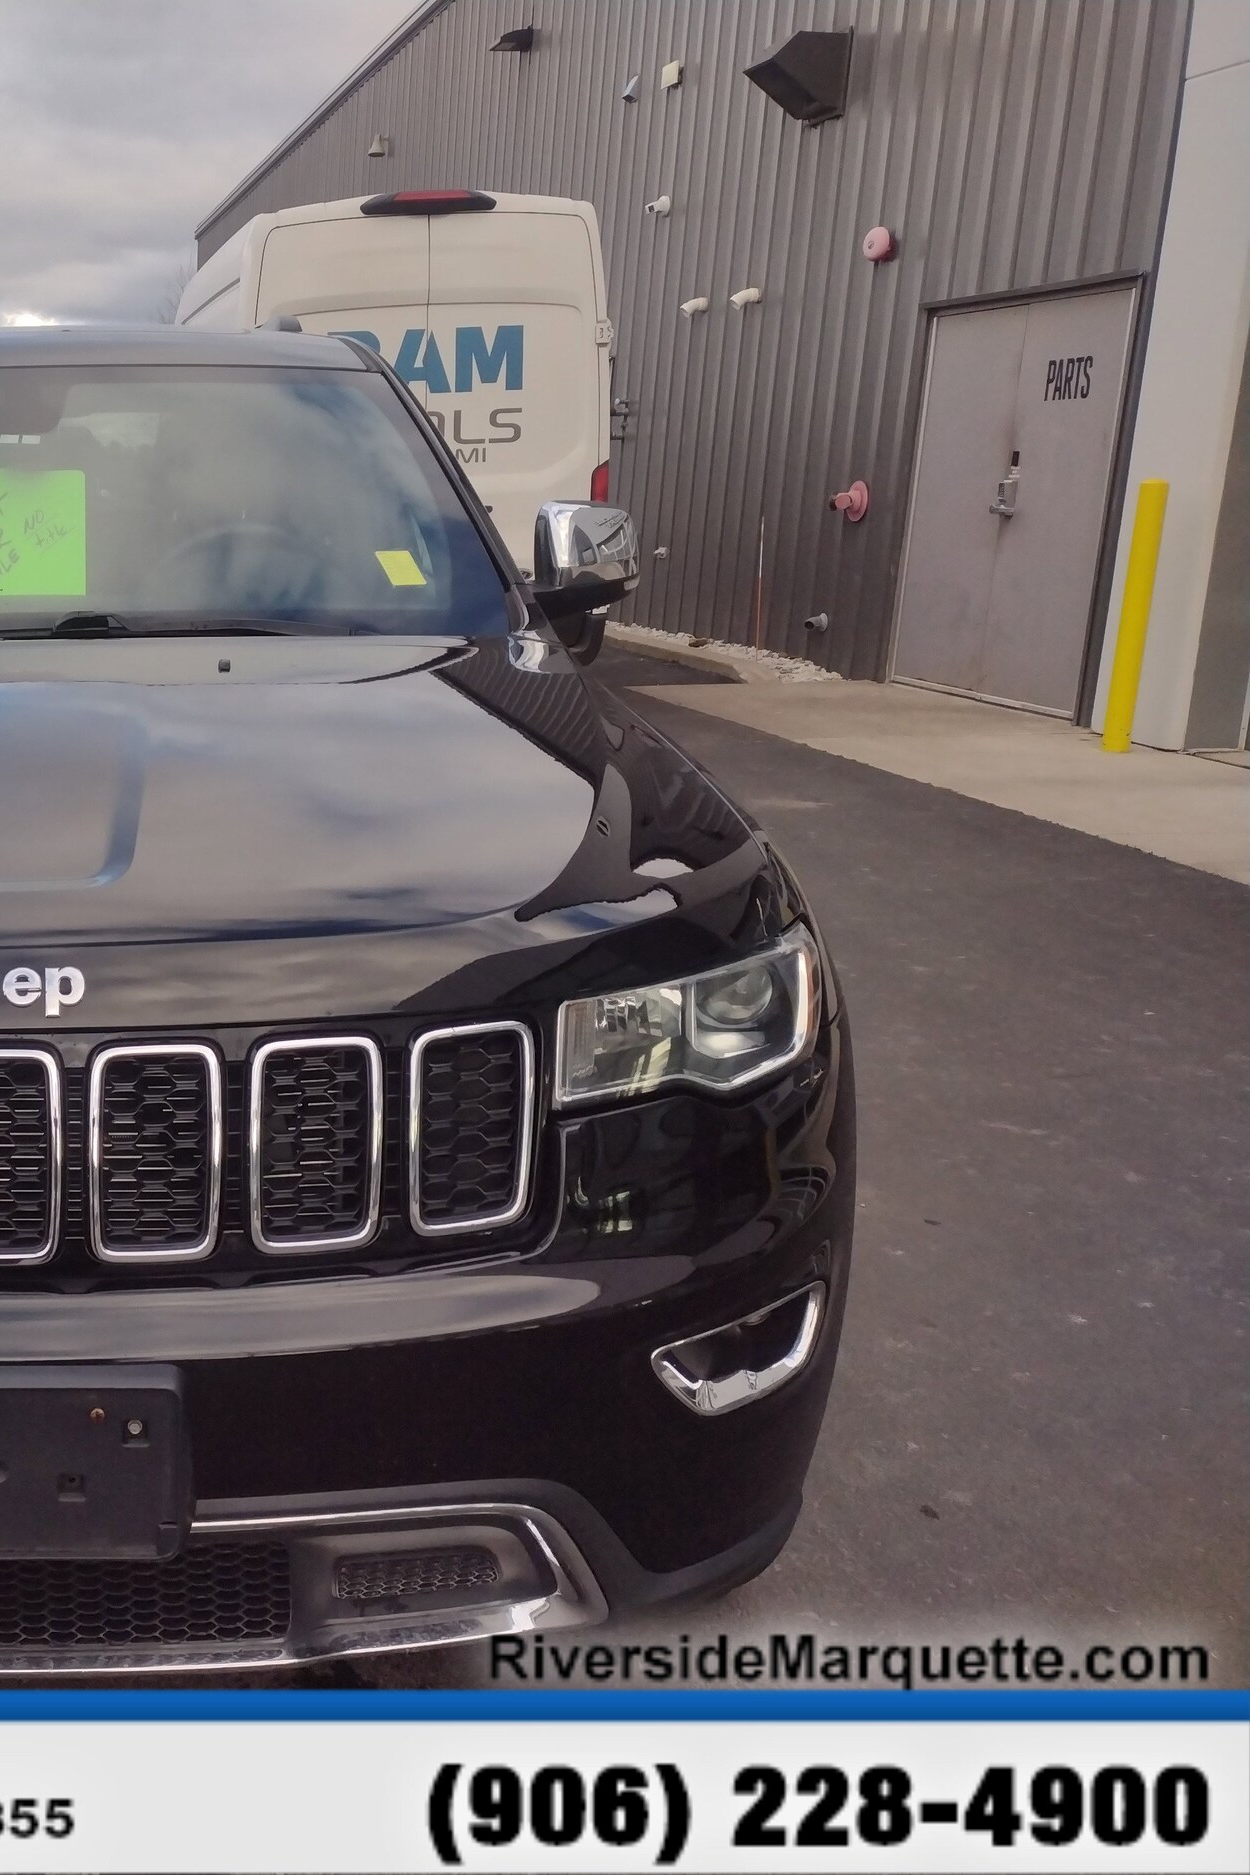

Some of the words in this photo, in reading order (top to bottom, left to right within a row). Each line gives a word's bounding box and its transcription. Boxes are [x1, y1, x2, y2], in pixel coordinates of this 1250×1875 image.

[1044, 355, 1093, 401] PARTS
[426, 407, 523, 444] LS
[455, 447, 487, 464] MI
[23, 508, 45, 534] NO
